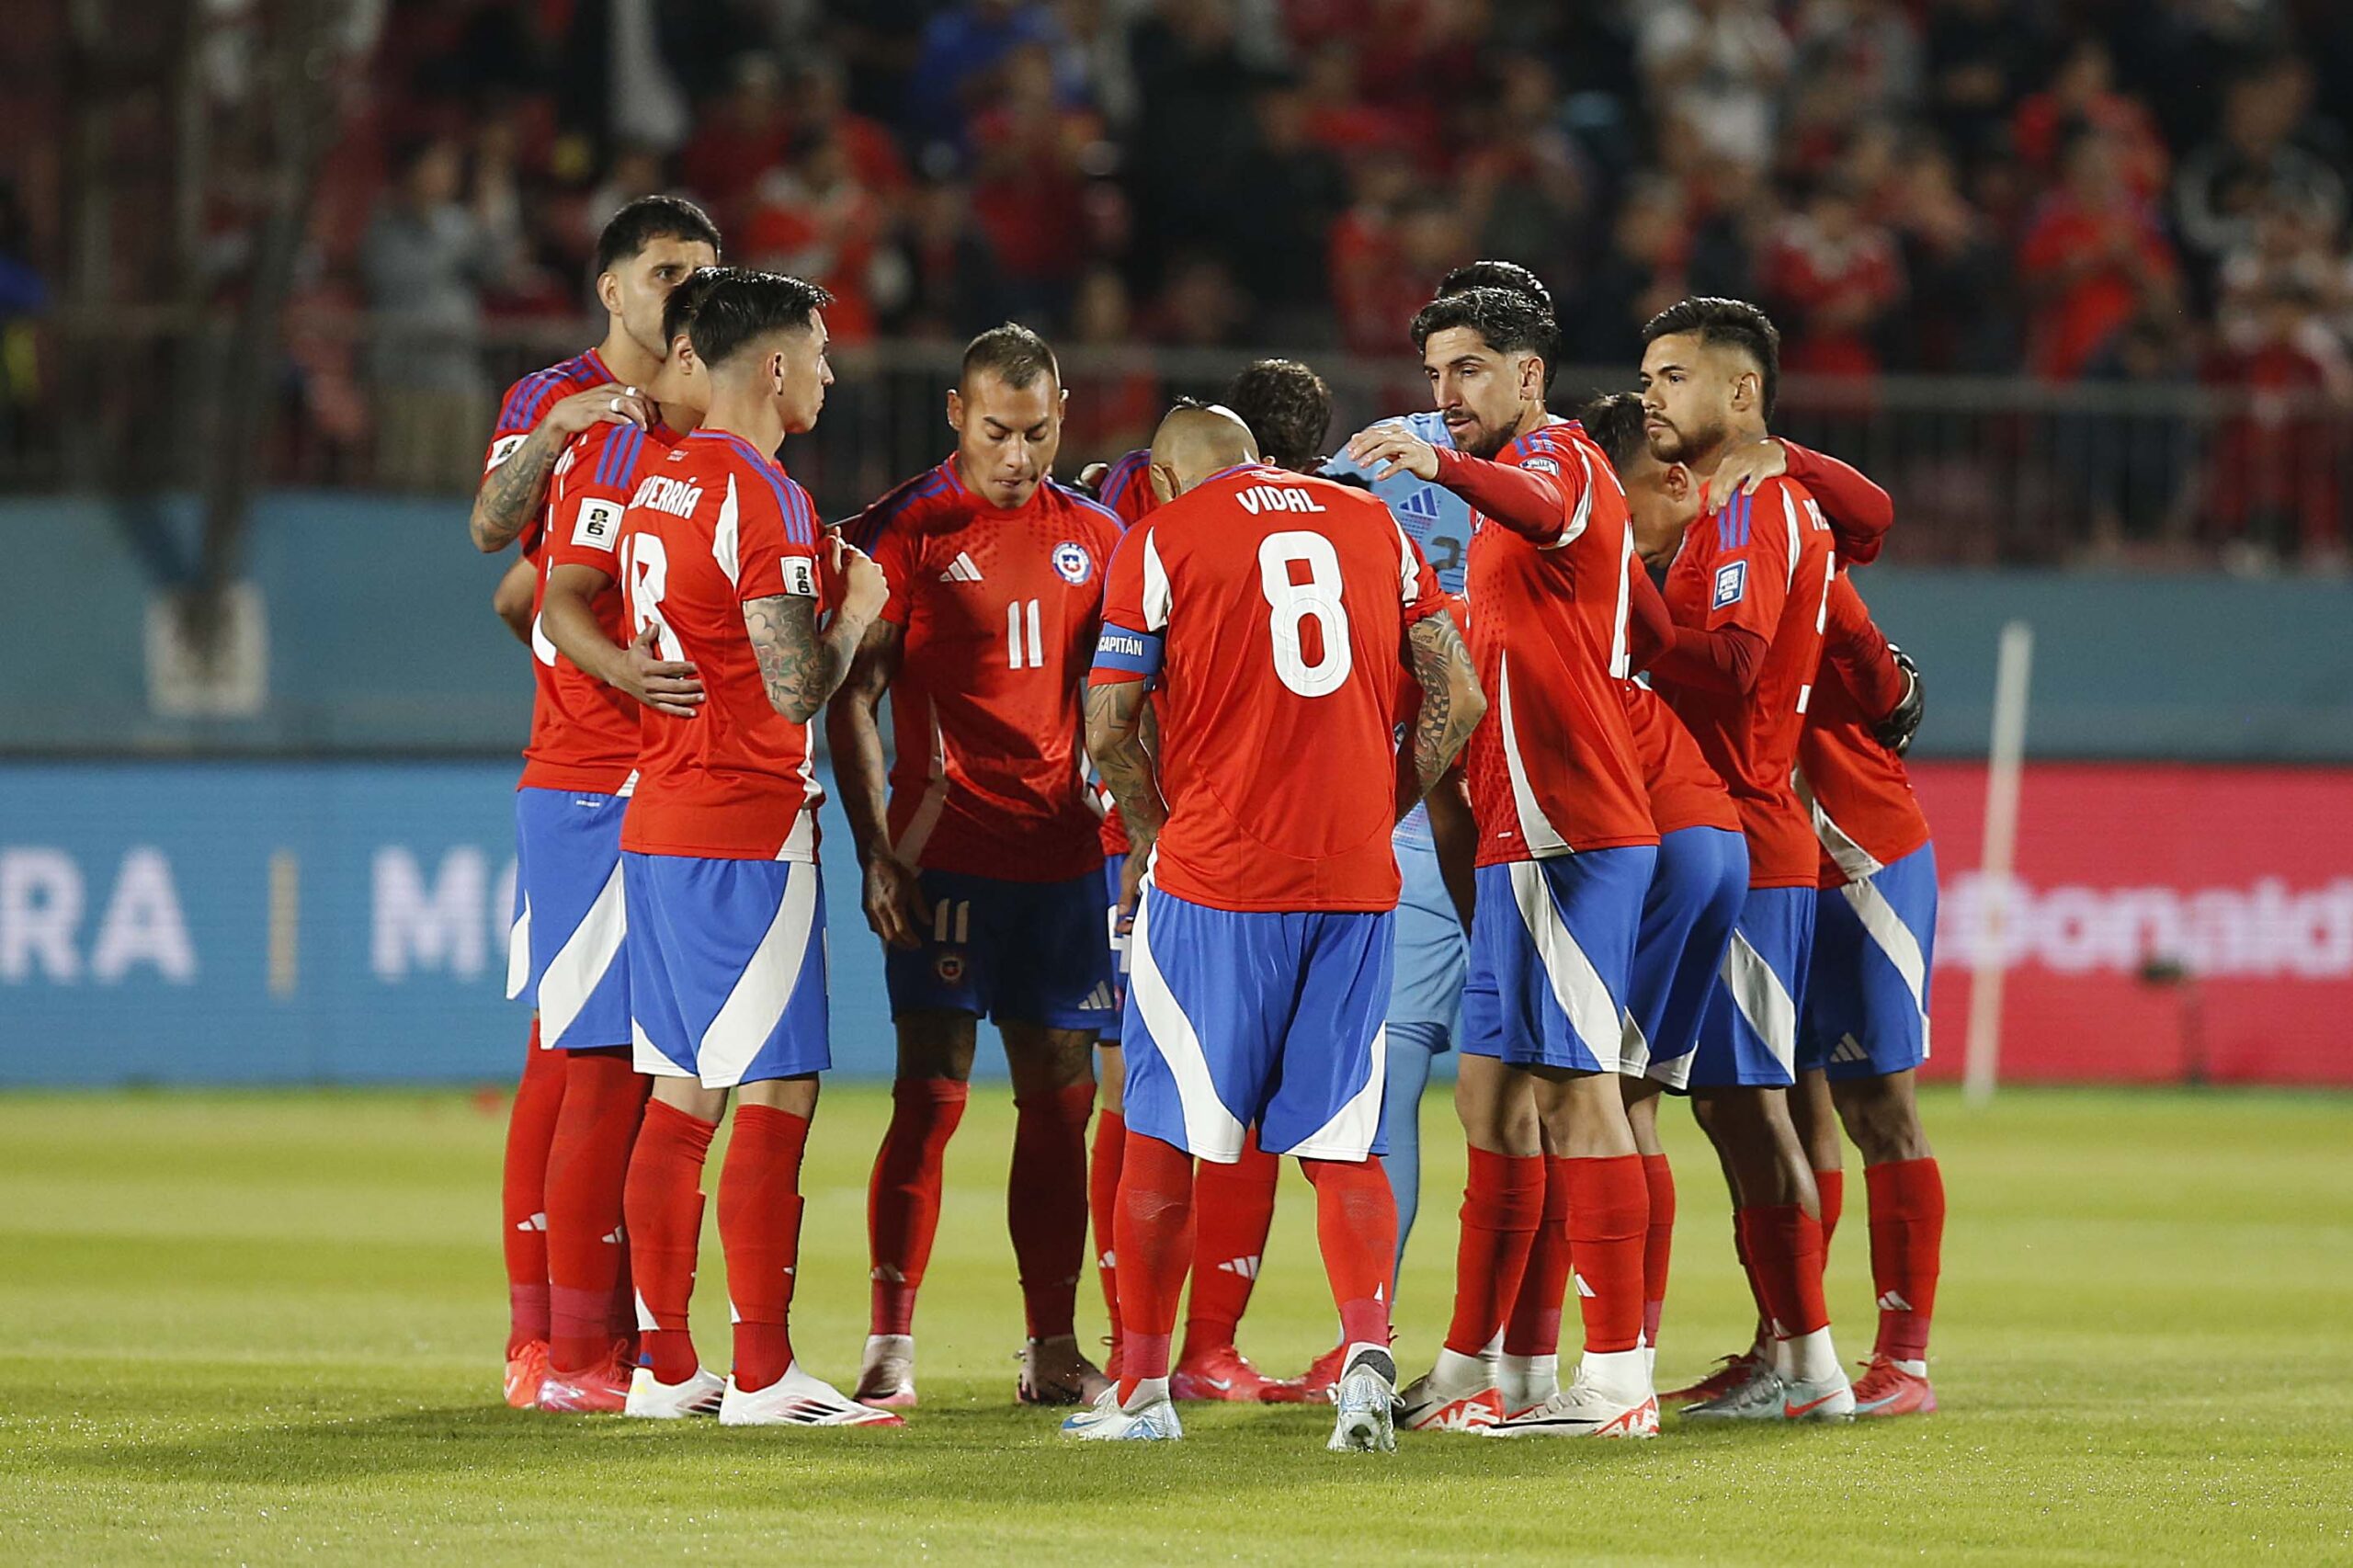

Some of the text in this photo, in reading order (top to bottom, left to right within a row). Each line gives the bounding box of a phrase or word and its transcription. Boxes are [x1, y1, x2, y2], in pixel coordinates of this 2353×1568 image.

[1234, 484, 1327, 516] VIDAL
[1006, 597, 1044, 670] 11
[1257, 529, 1354, 699] 8
[1097, 635, 1143, 657] CAPITÁN
[933, 897, 971, 944] 11
